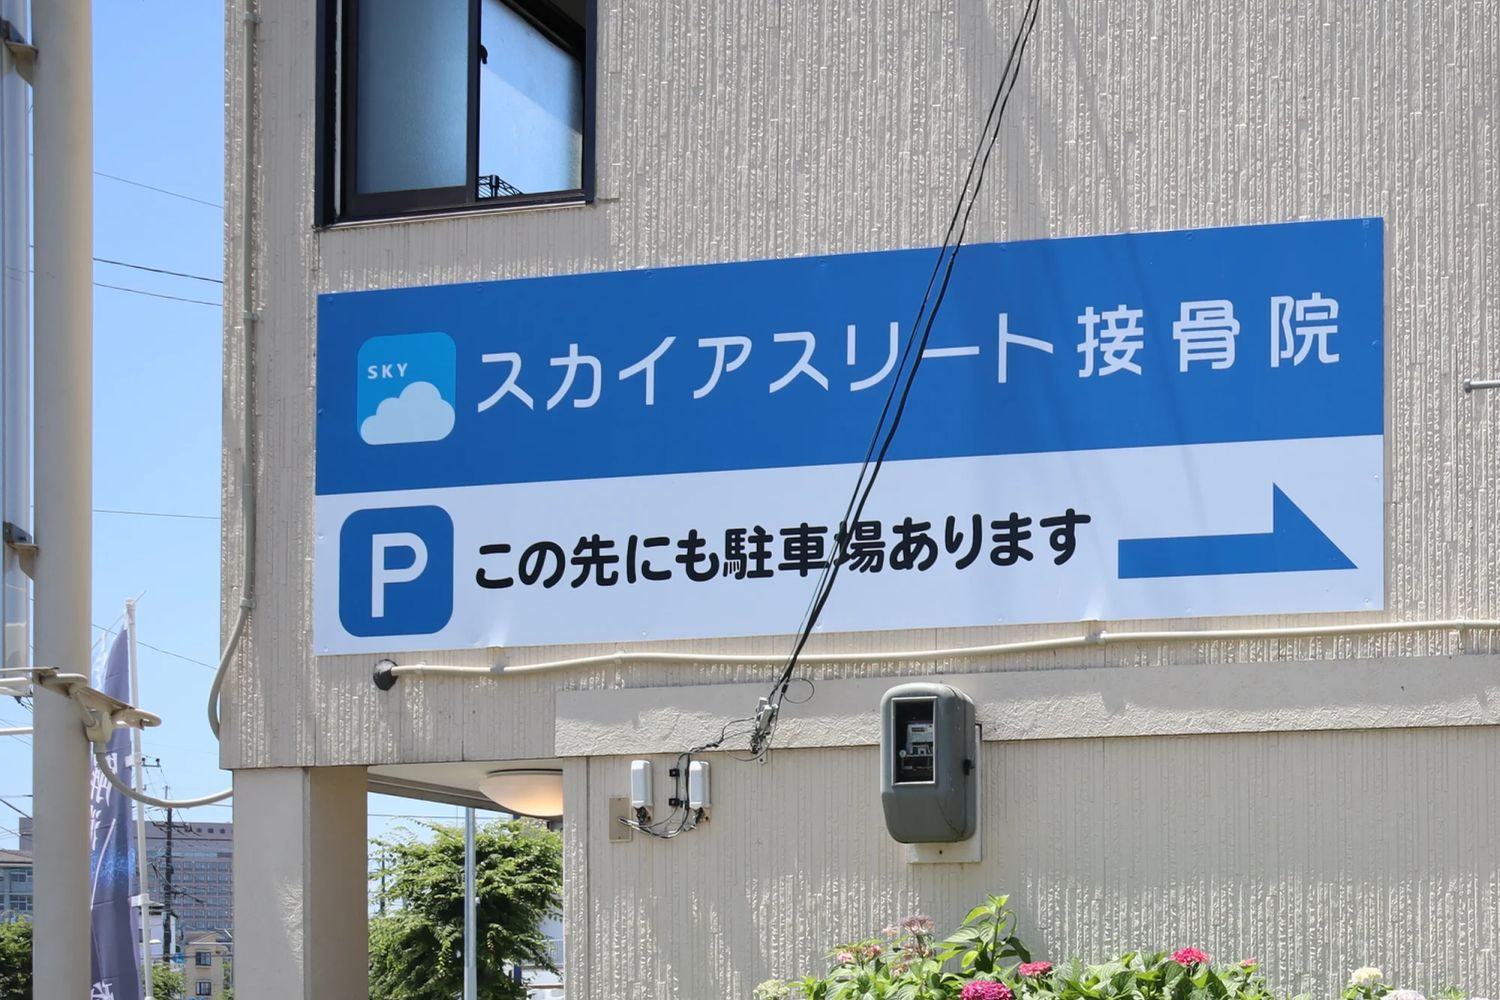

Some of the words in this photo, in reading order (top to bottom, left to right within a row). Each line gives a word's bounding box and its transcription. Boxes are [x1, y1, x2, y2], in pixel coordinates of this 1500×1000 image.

[367, 362, 409, 380] SKY
[477, 292, 1340, 413] スカイアスリート接骨院
[371, 532, 428, 618] P
[475, 507, 1092, 590] この先にも駐車場あります
